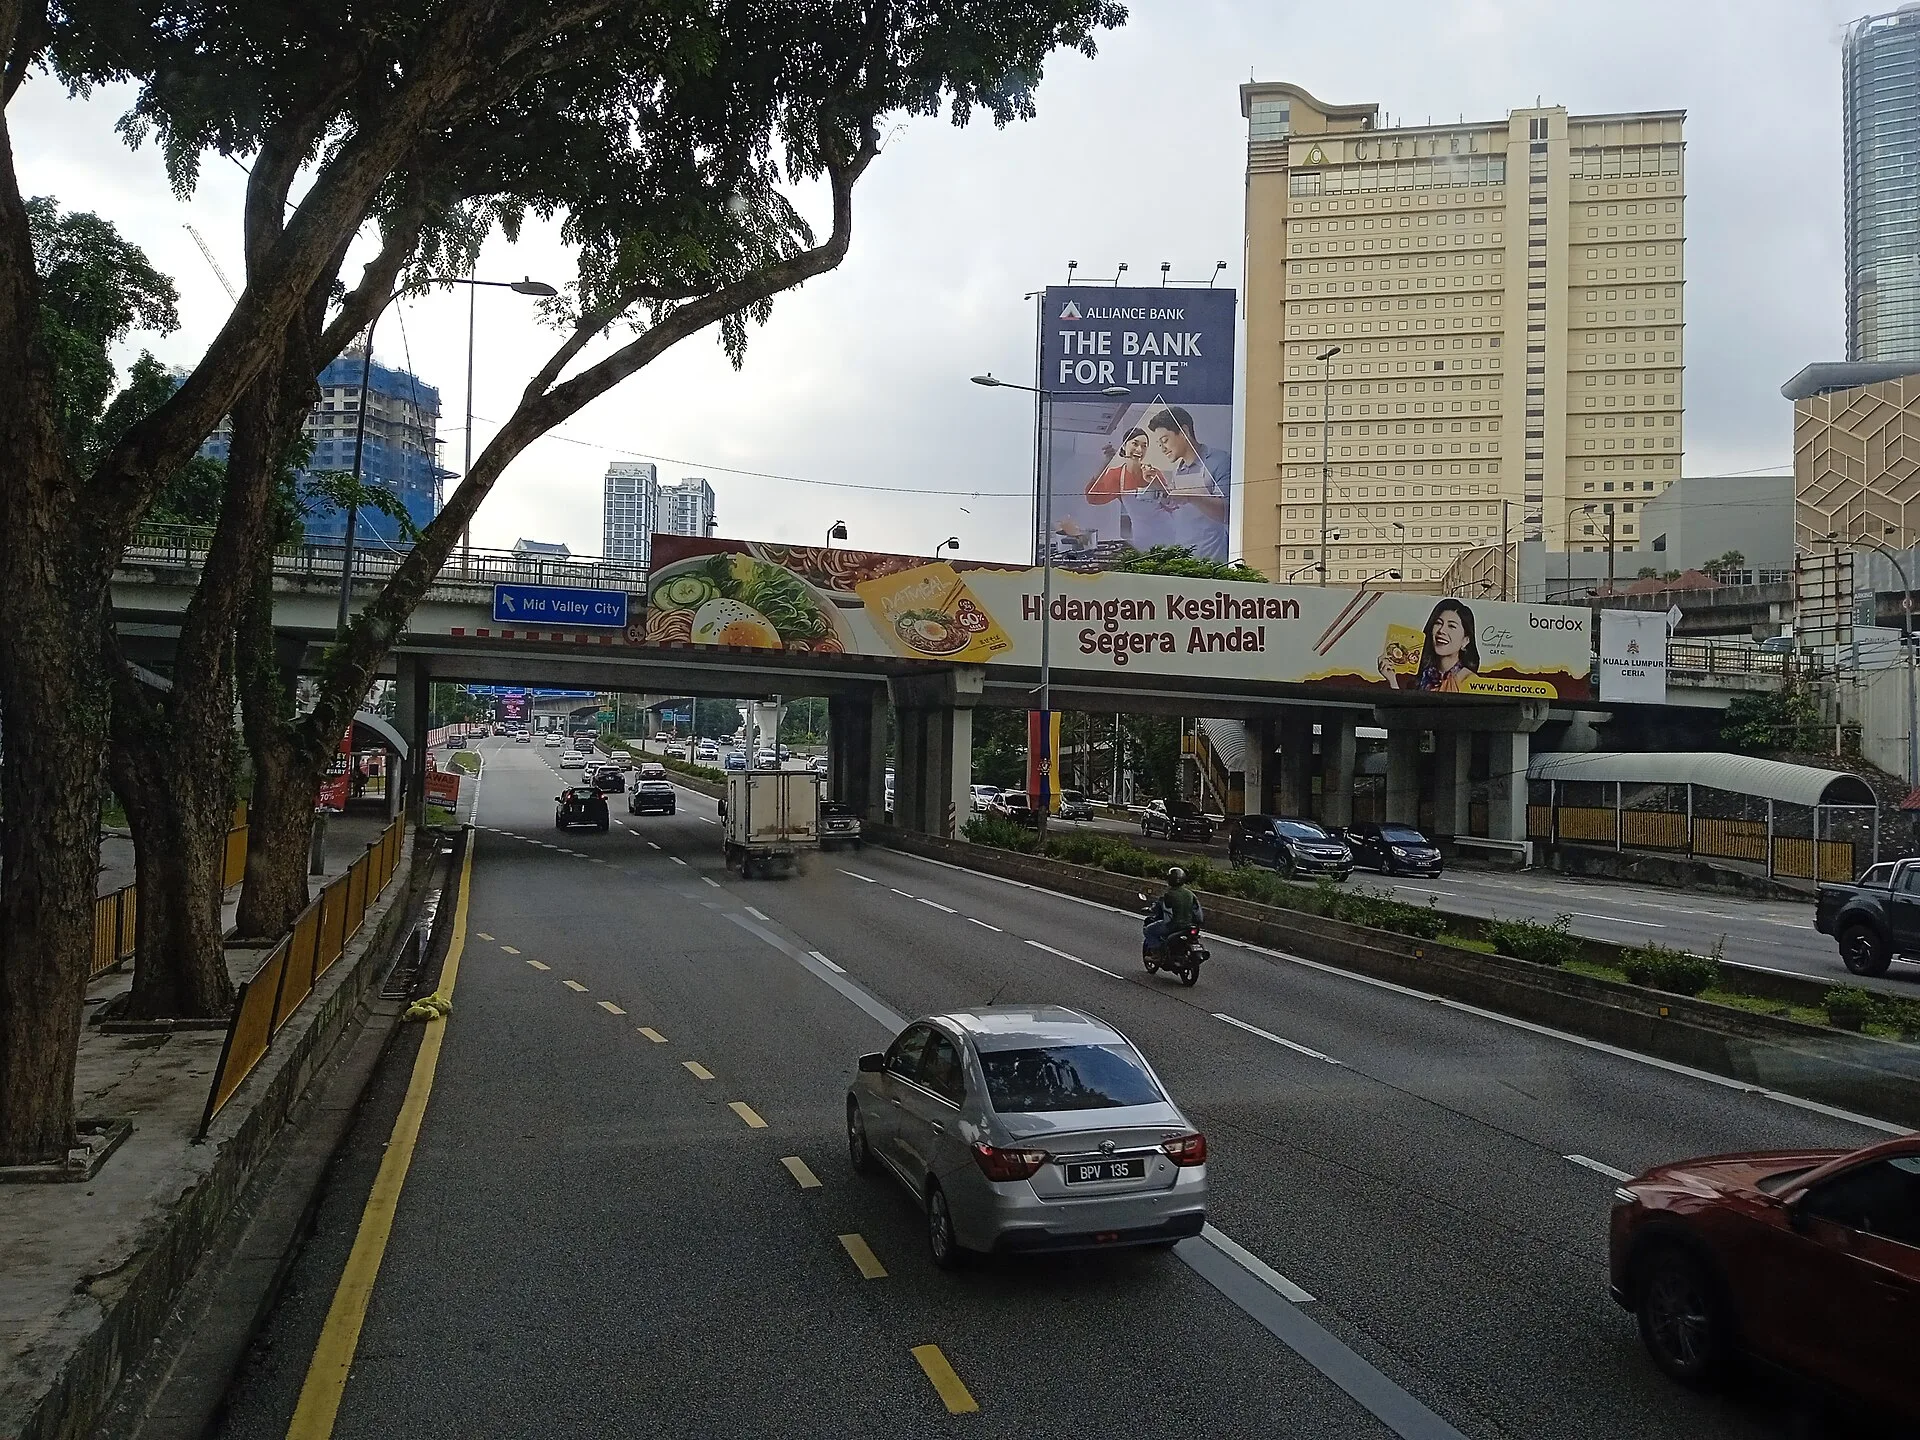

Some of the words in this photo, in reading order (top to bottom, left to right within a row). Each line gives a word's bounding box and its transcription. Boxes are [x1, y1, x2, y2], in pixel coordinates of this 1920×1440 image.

[1354, 137, 1479, 161] CITITEL
[1086, 307, 1146, 320] ALLIANCE
[1149, 308, 1185, 320] BANK
[1059, 330, 1112, 355] THE
[1122, 332, 1203, 357] BANK
[1059, 359, 1116, 384] FOR
[523, 598, 546, 611] Mid
[551, 600, 589, 615] Valley
[594, 602, 620, 617] City
[1166, 591, 1300, 621] Kesihatan
[1529, 612, 1583, 632] bardox
[1078, 628, 1176, 666] Segera
[1187, 626, 1266, 655] Anda!
[1602, 657, 1630, 667] KUALA
[1631, 658, 1664, 668] LUMPUR
[1621, 668, 1646, 678] CERIA
[1469, 680, 1547, 695] www.bardox.co
[1080, 1166, 1101, 1180] BPV
[1109, 1163, 1129, 1177] 135
